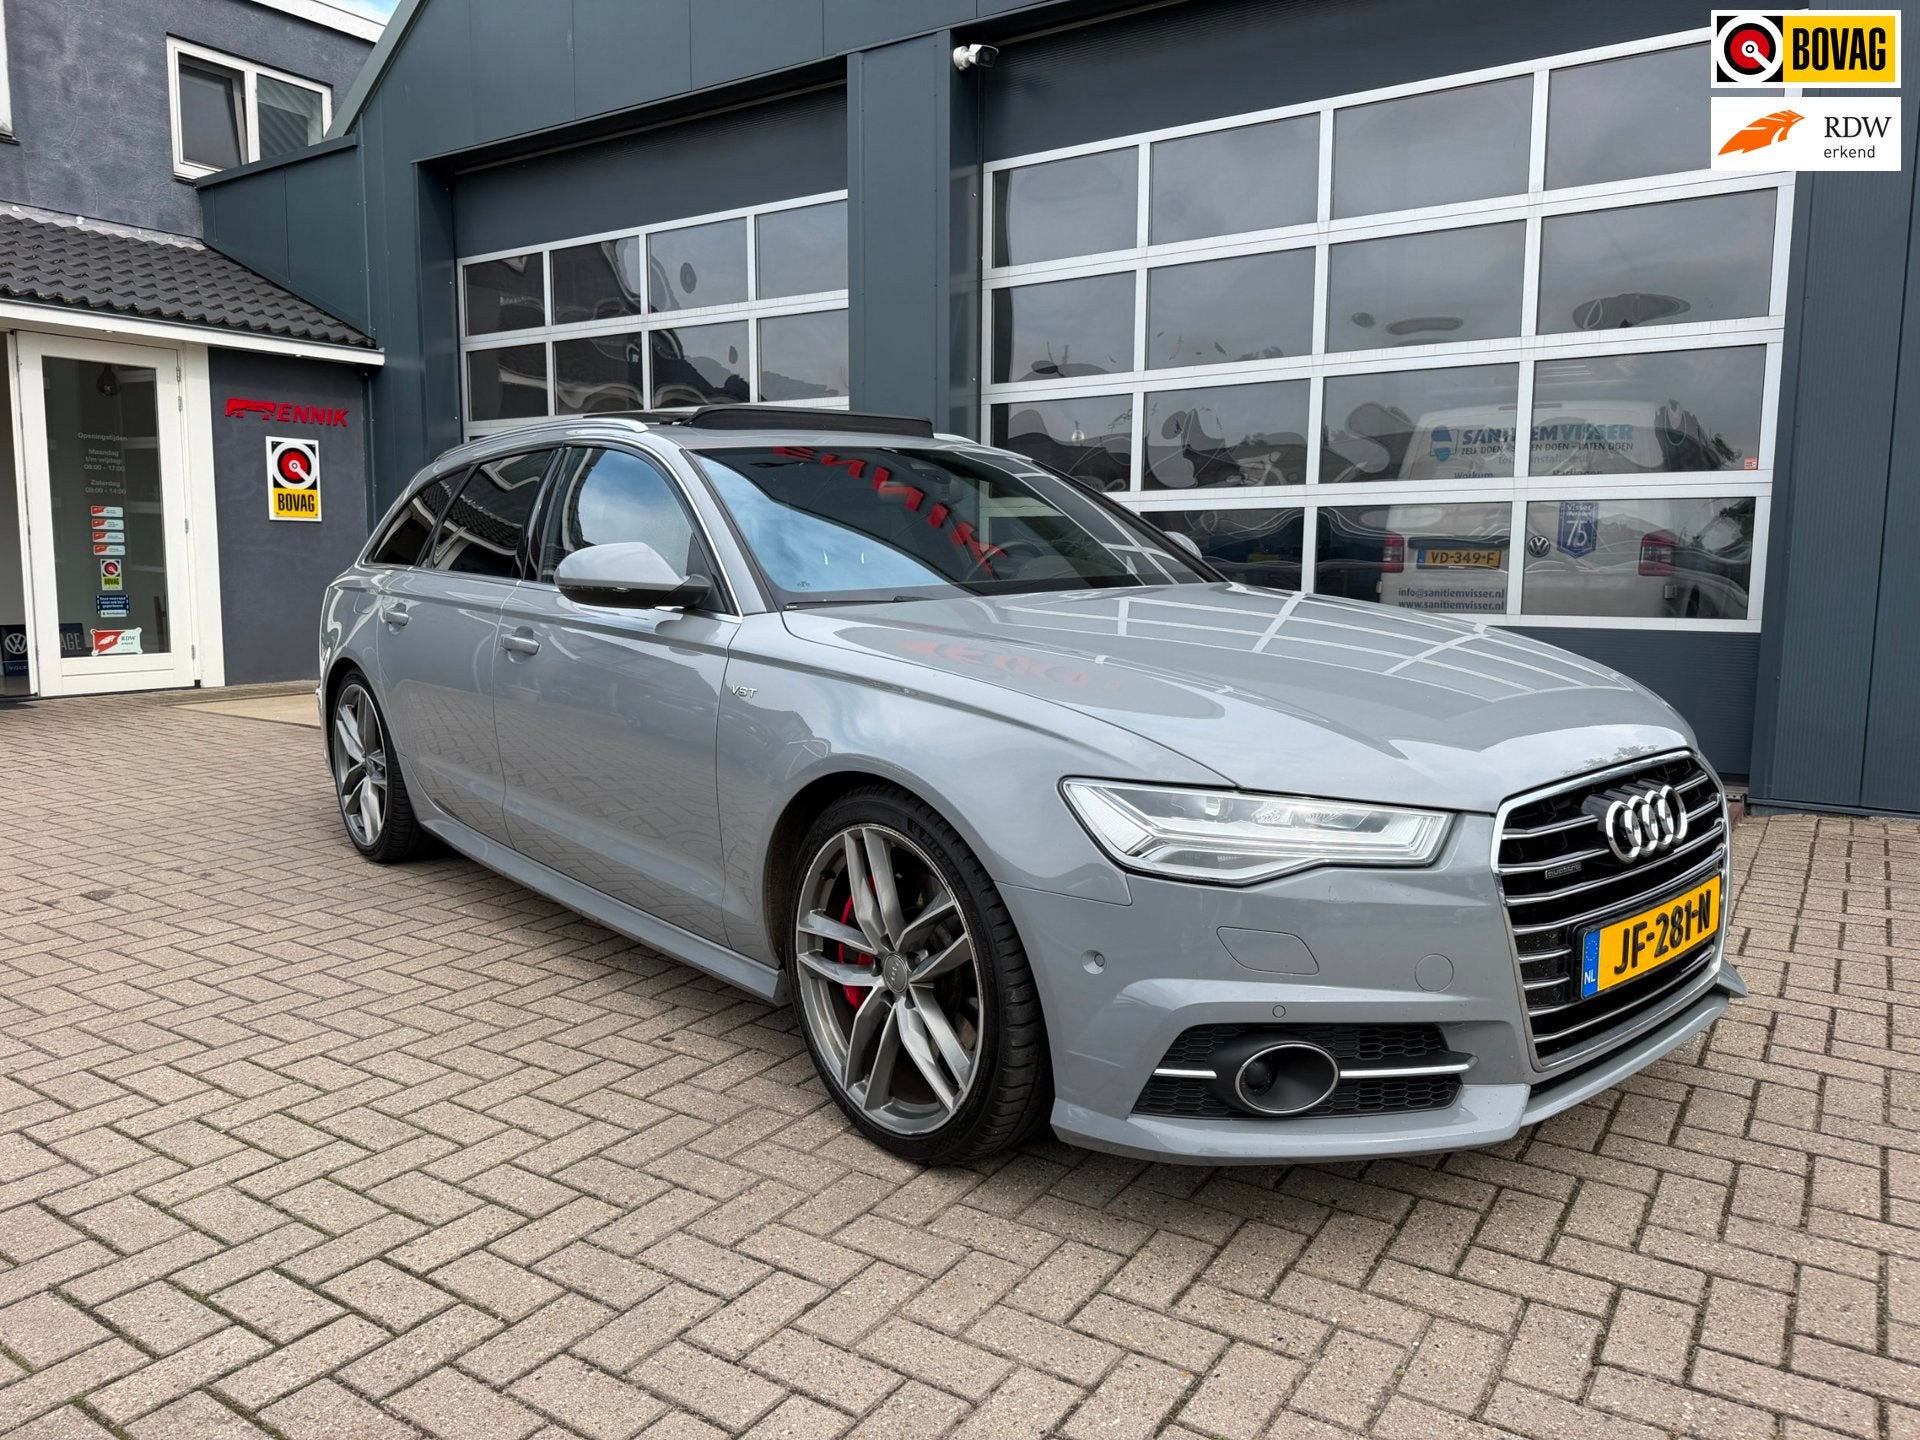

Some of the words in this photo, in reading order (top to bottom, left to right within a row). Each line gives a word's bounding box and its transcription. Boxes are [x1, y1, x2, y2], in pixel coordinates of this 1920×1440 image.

[277, 493, 315, 512] BOVAG
[1430, 552, 1495, 564] VD-349-F
[1398, 587, 1505, 599] info@sanitiemvisser.nl
[1399, 600, 1504, 611] www.sanitiemvisser.nl
[60, 633, 82, 651] AGE
[1614, 889, 1711, 975] JF-281-N
[1584, 969, 1596, 985] NL
